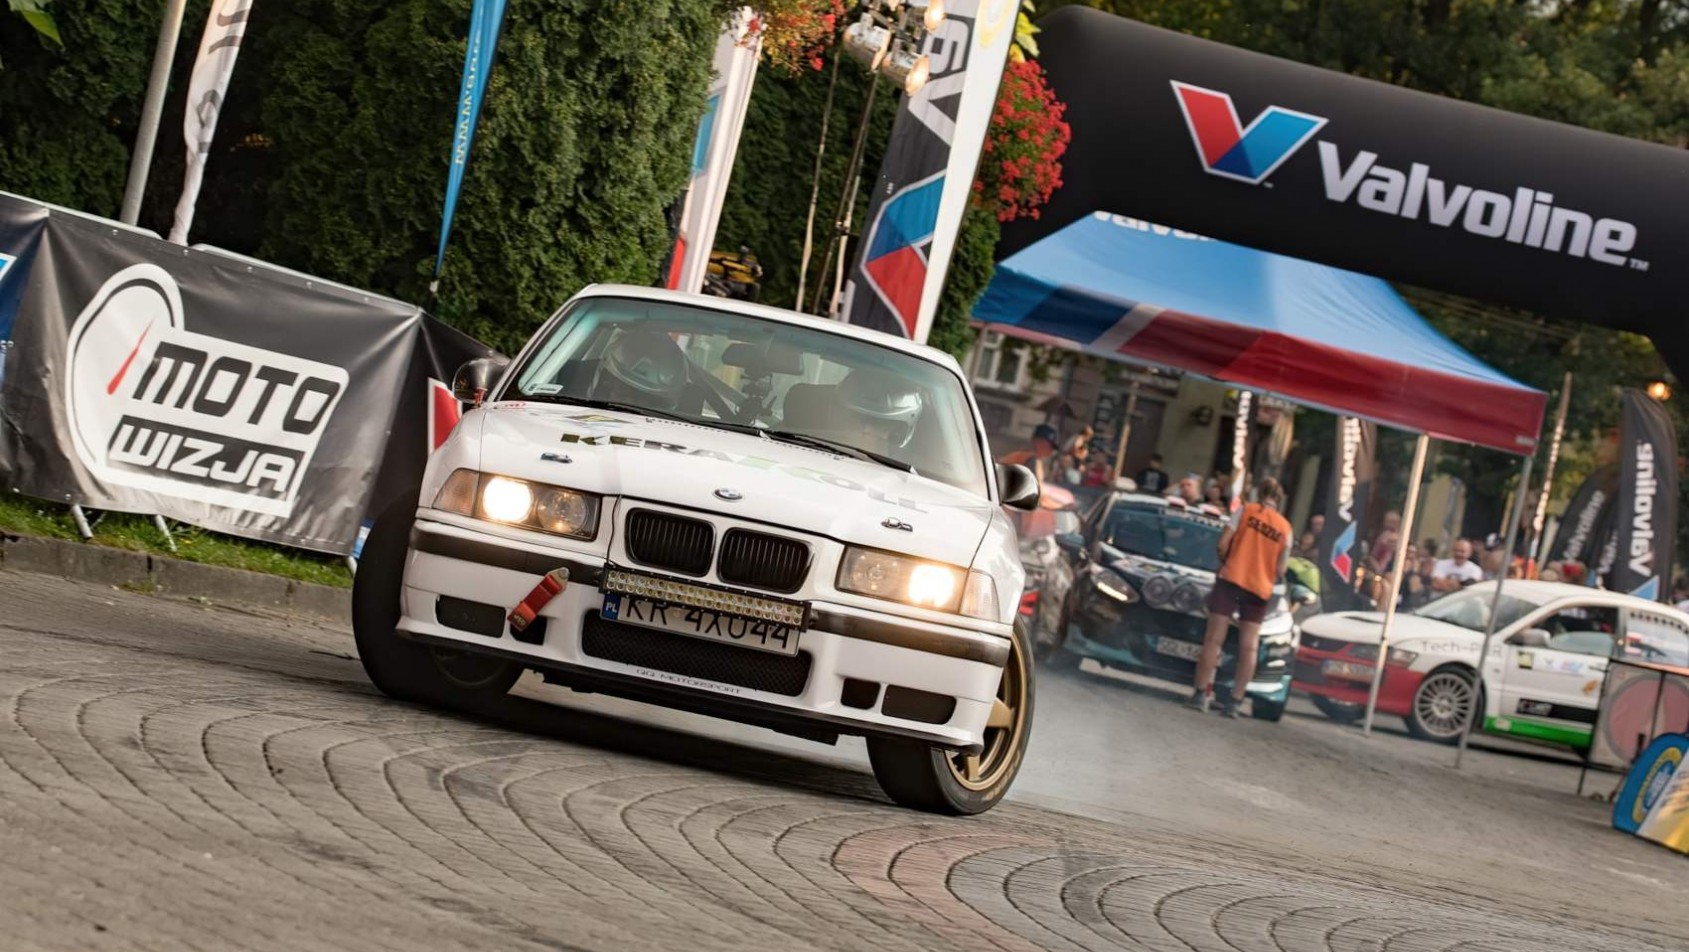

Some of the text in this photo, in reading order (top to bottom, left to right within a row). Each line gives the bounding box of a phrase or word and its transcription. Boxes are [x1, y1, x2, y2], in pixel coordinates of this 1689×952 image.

[1317, 140, 1638, 267] Valvoline
[132, 340, 342, 435] MOTO
[109, 421, 297, 492] WIZJA
[605, 600, 618, 614] PL
[660, 672, 741, 695] MOTORSPORT
